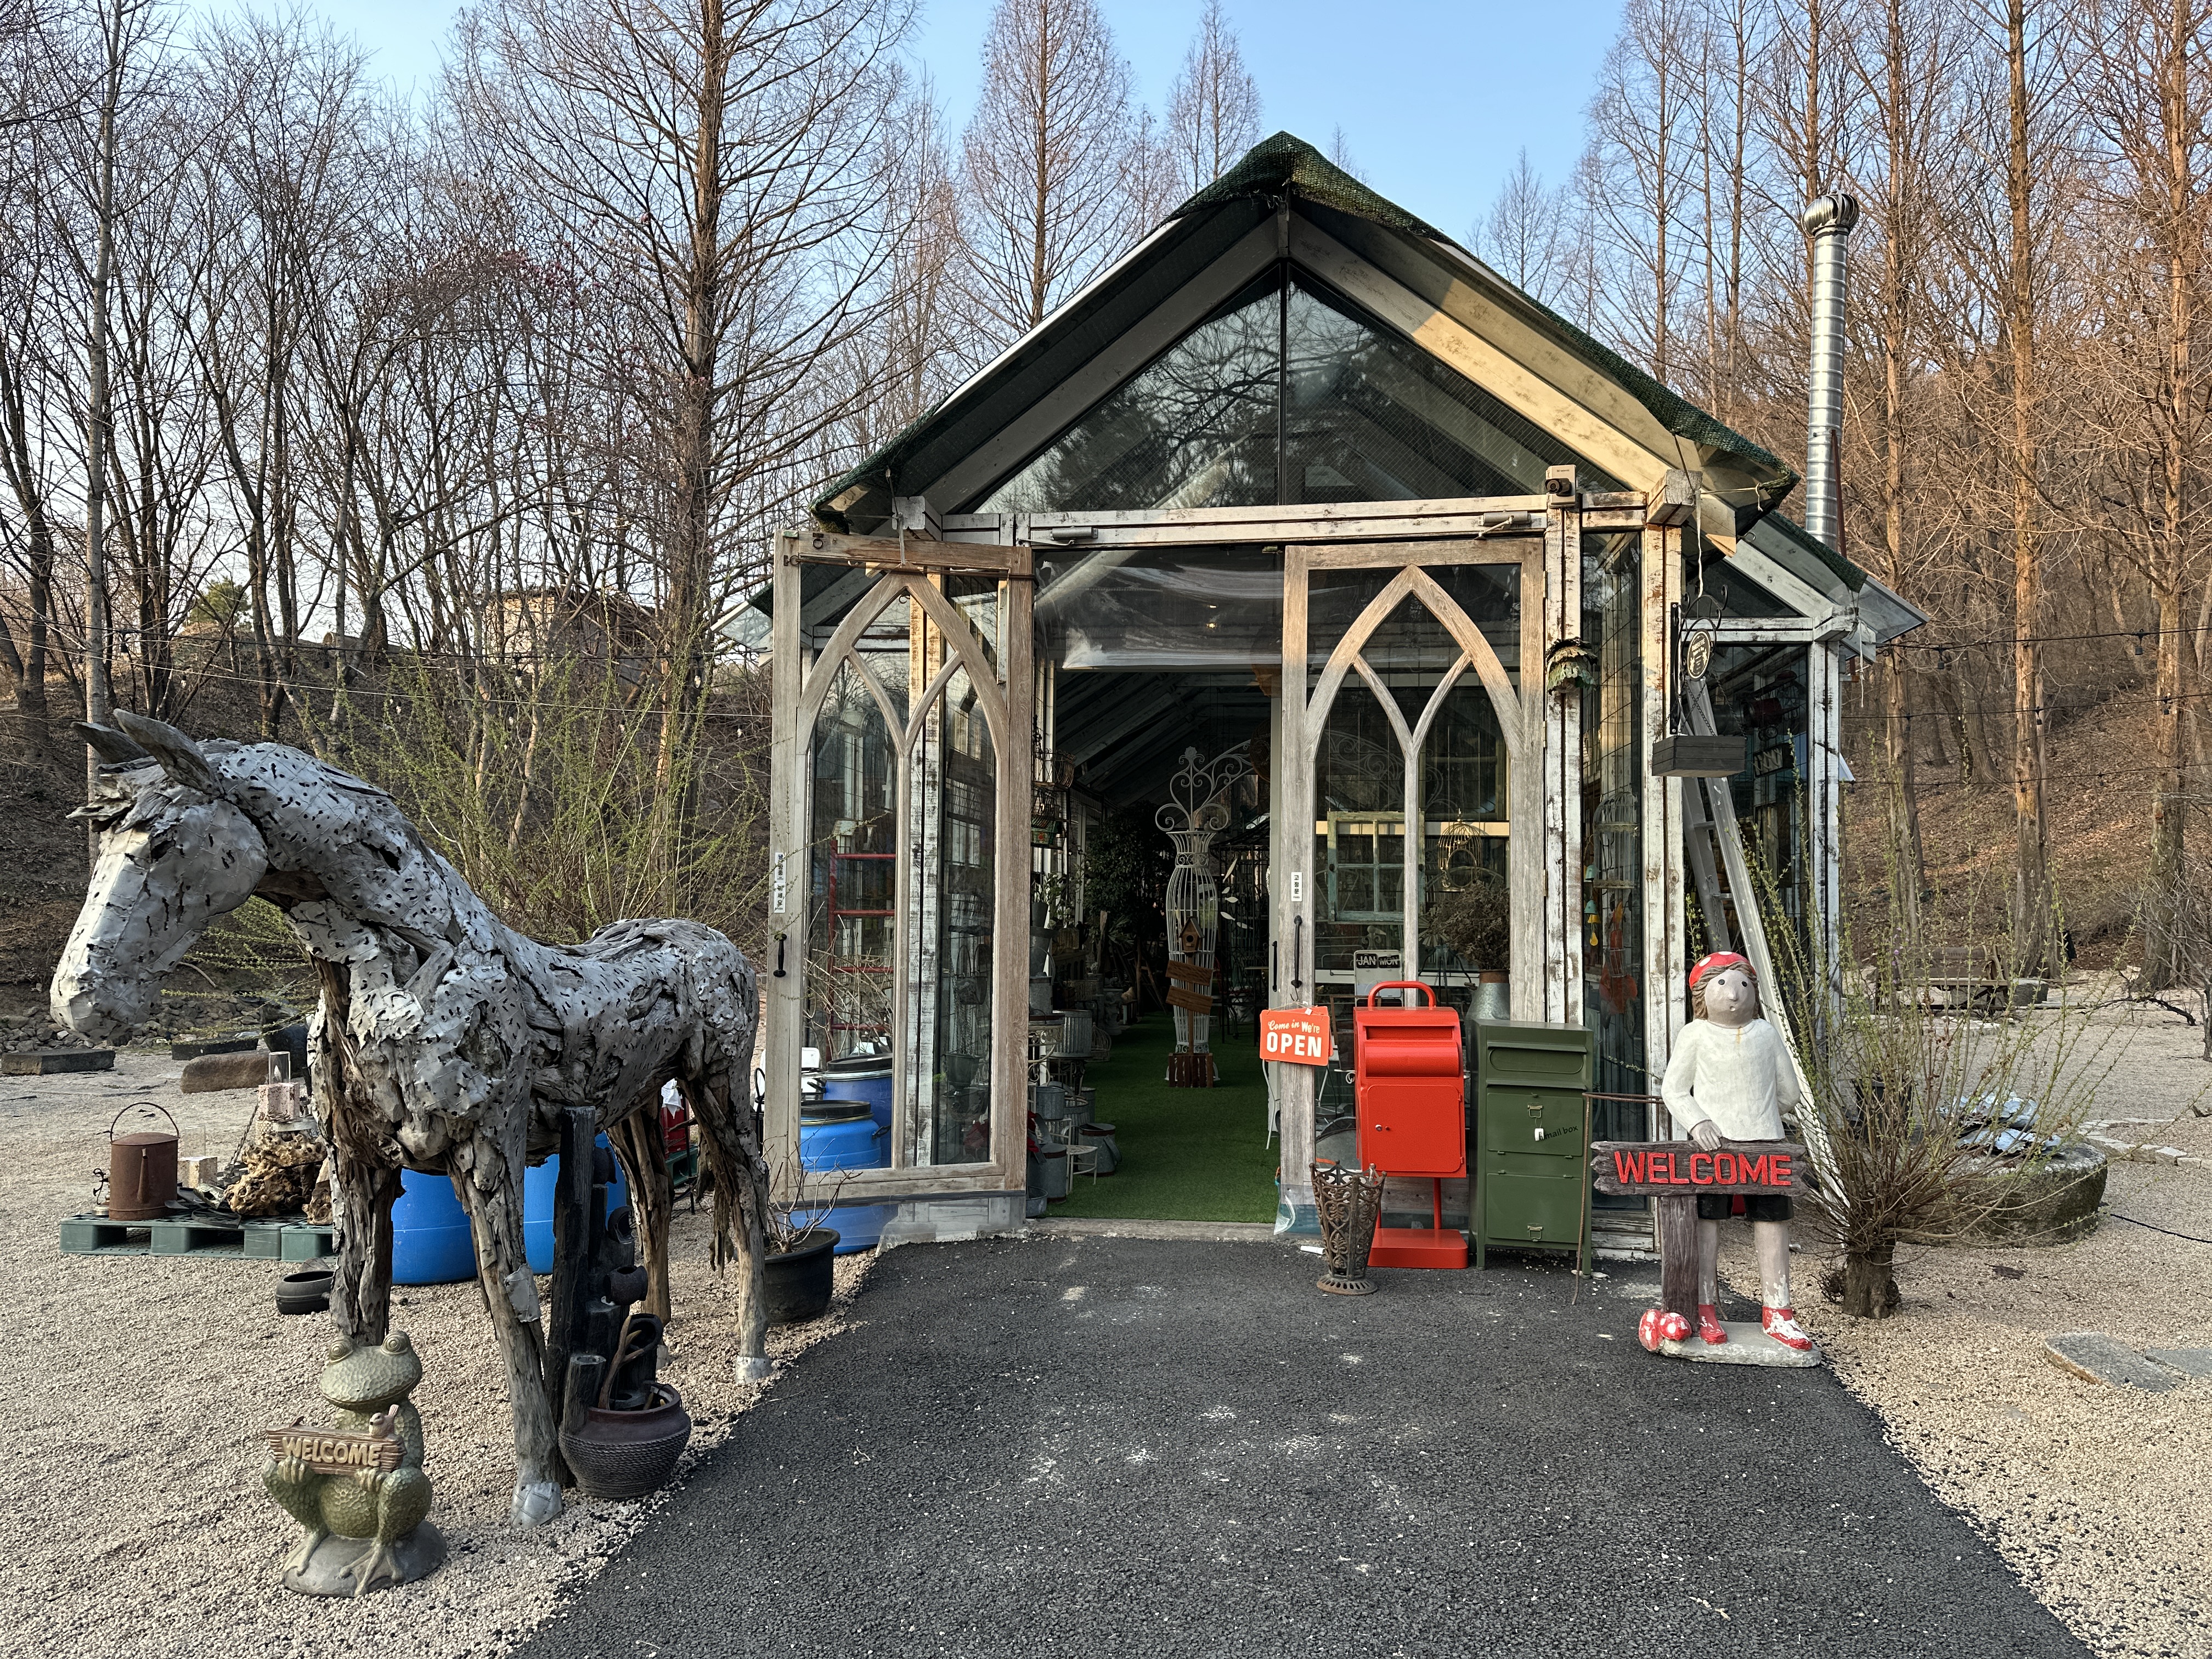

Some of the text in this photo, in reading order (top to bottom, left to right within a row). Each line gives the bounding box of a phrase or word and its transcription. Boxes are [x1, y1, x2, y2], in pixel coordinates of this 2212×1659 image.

[1358, 956, 1398, 965] JAN MON
[1268, 1019, 1321, 1034] Come in We're
[1266, 1031, 1322, 1058] OPEN
[1562, 1126, 1578, 1135] box
[1614, 1150, 1791, 1186] WELCOME
[281, 1436, 383, 1467] WELCOME
